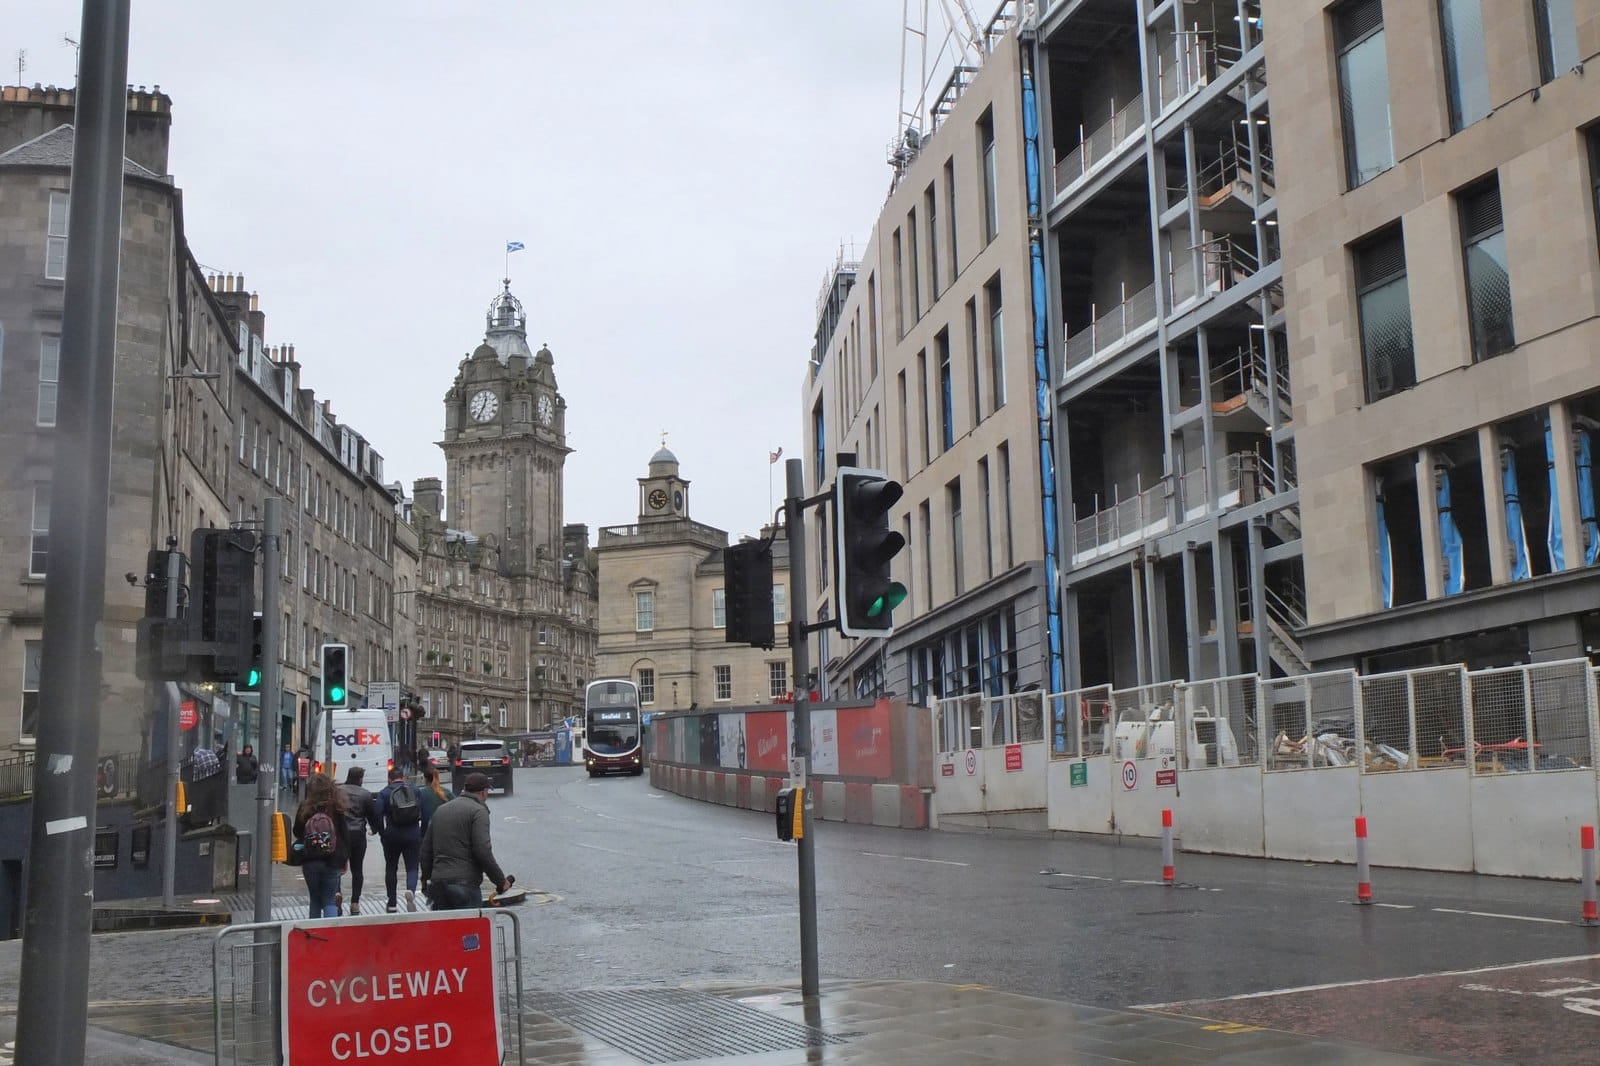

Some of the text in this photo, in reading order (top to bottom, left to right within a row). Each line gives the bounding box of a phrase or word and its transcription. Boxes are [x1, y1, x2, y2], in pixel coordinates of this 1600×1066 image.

[1125, 769, 1134, 782] 10
[307, 967, 468, 1008] CYCLEWAY
[331, 1022, 453, 1061] CLOSED
